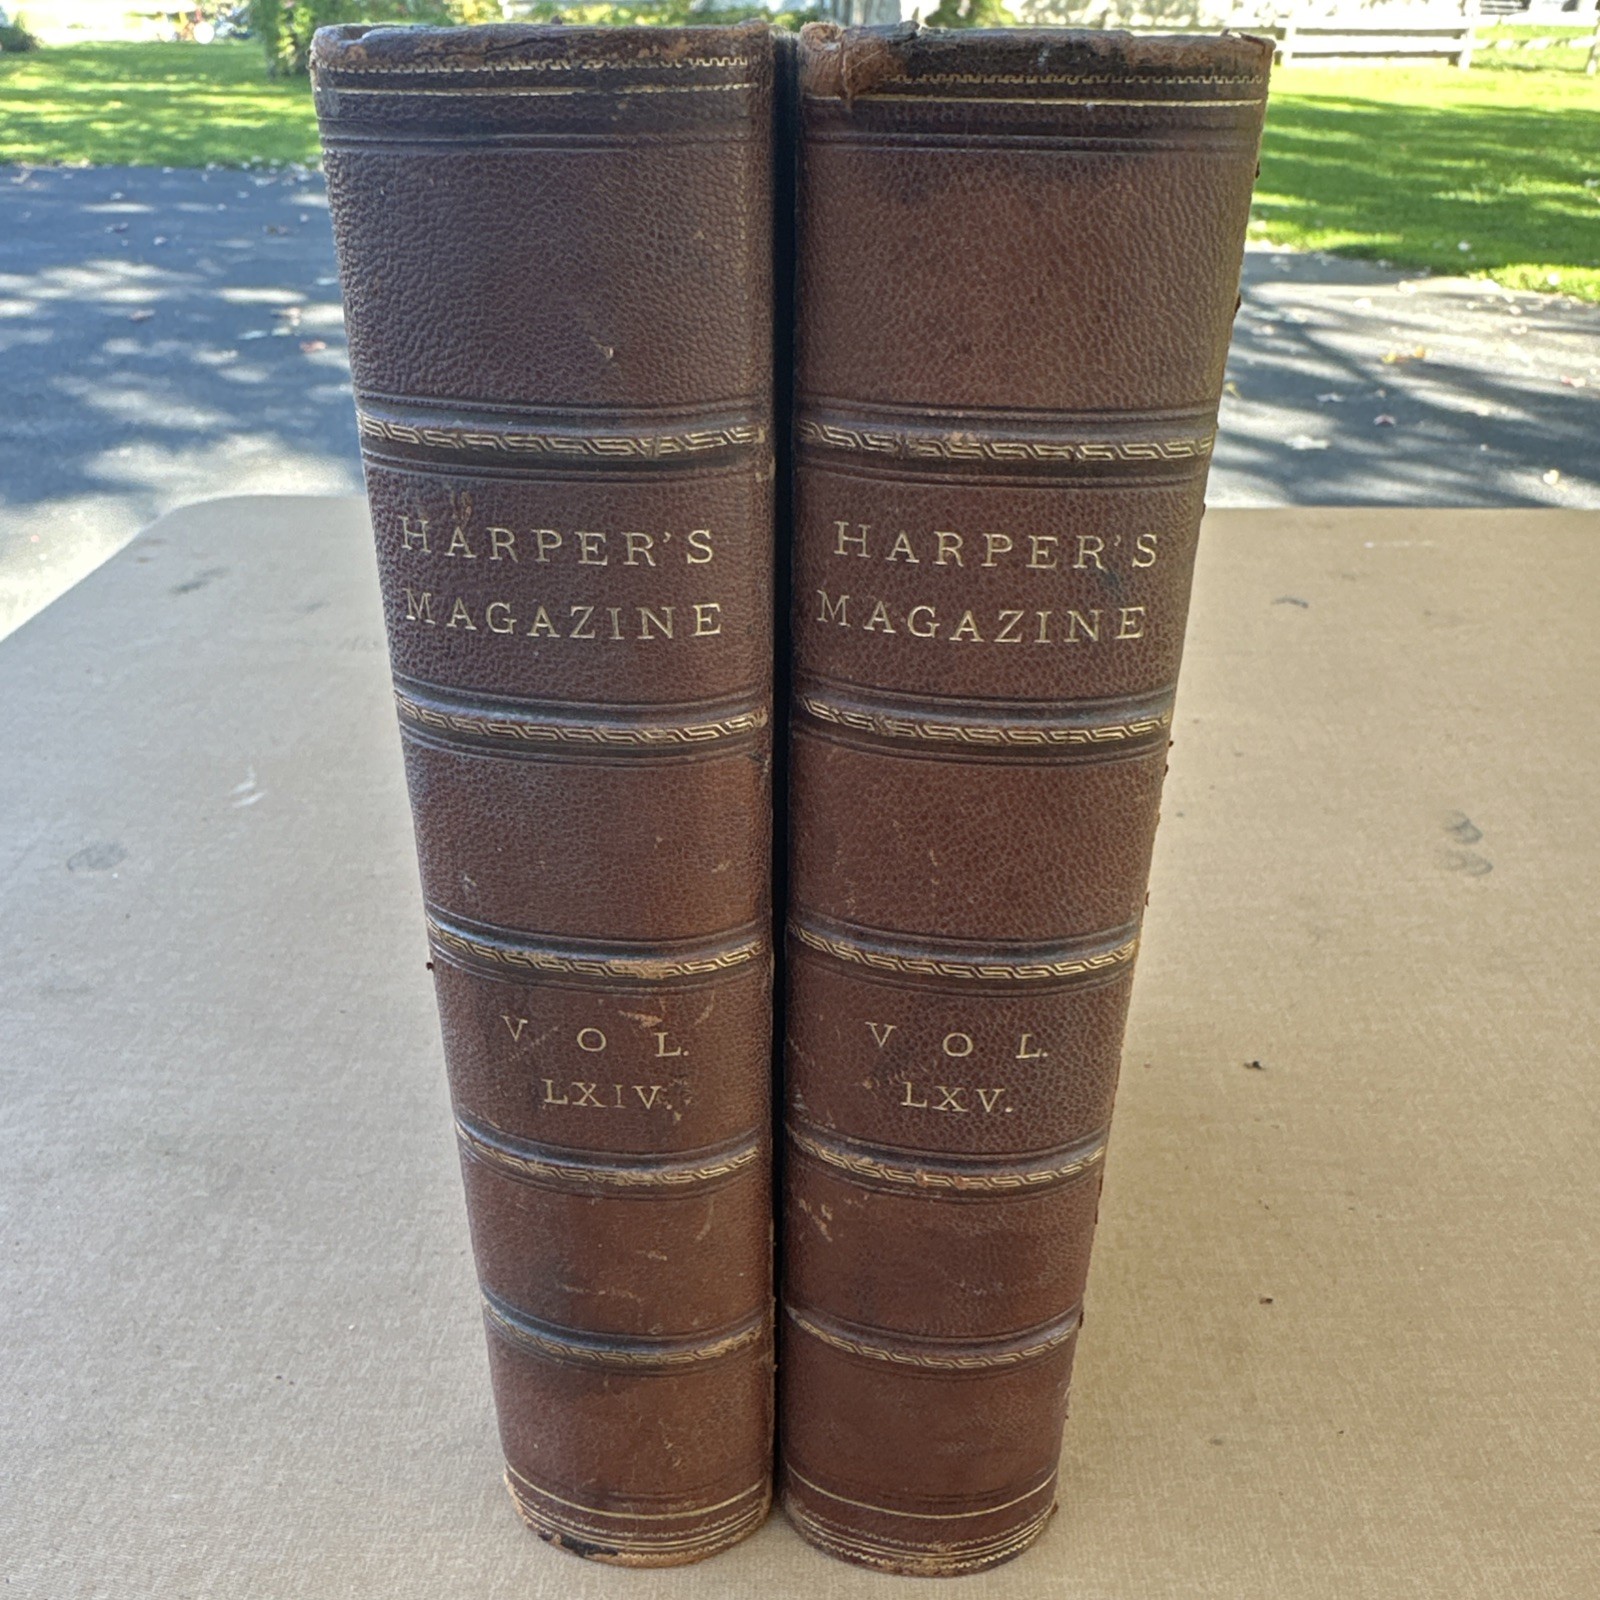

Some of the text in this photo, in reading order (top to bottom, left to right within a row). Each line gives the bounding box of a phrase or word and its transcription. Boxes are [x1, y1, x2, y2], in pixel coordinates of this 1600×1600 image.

[398, 515, 714, 566] HARPER'S
[833, 520, 1158, 571] HARPER'S
[402, 587, 722, 640] MAGAZINE
[816, 589, 1147, 643] MAGAZINE
[540, 1078, 673, 1110] LXIV.
[900, 1081, 1014, 1113] LXV.
